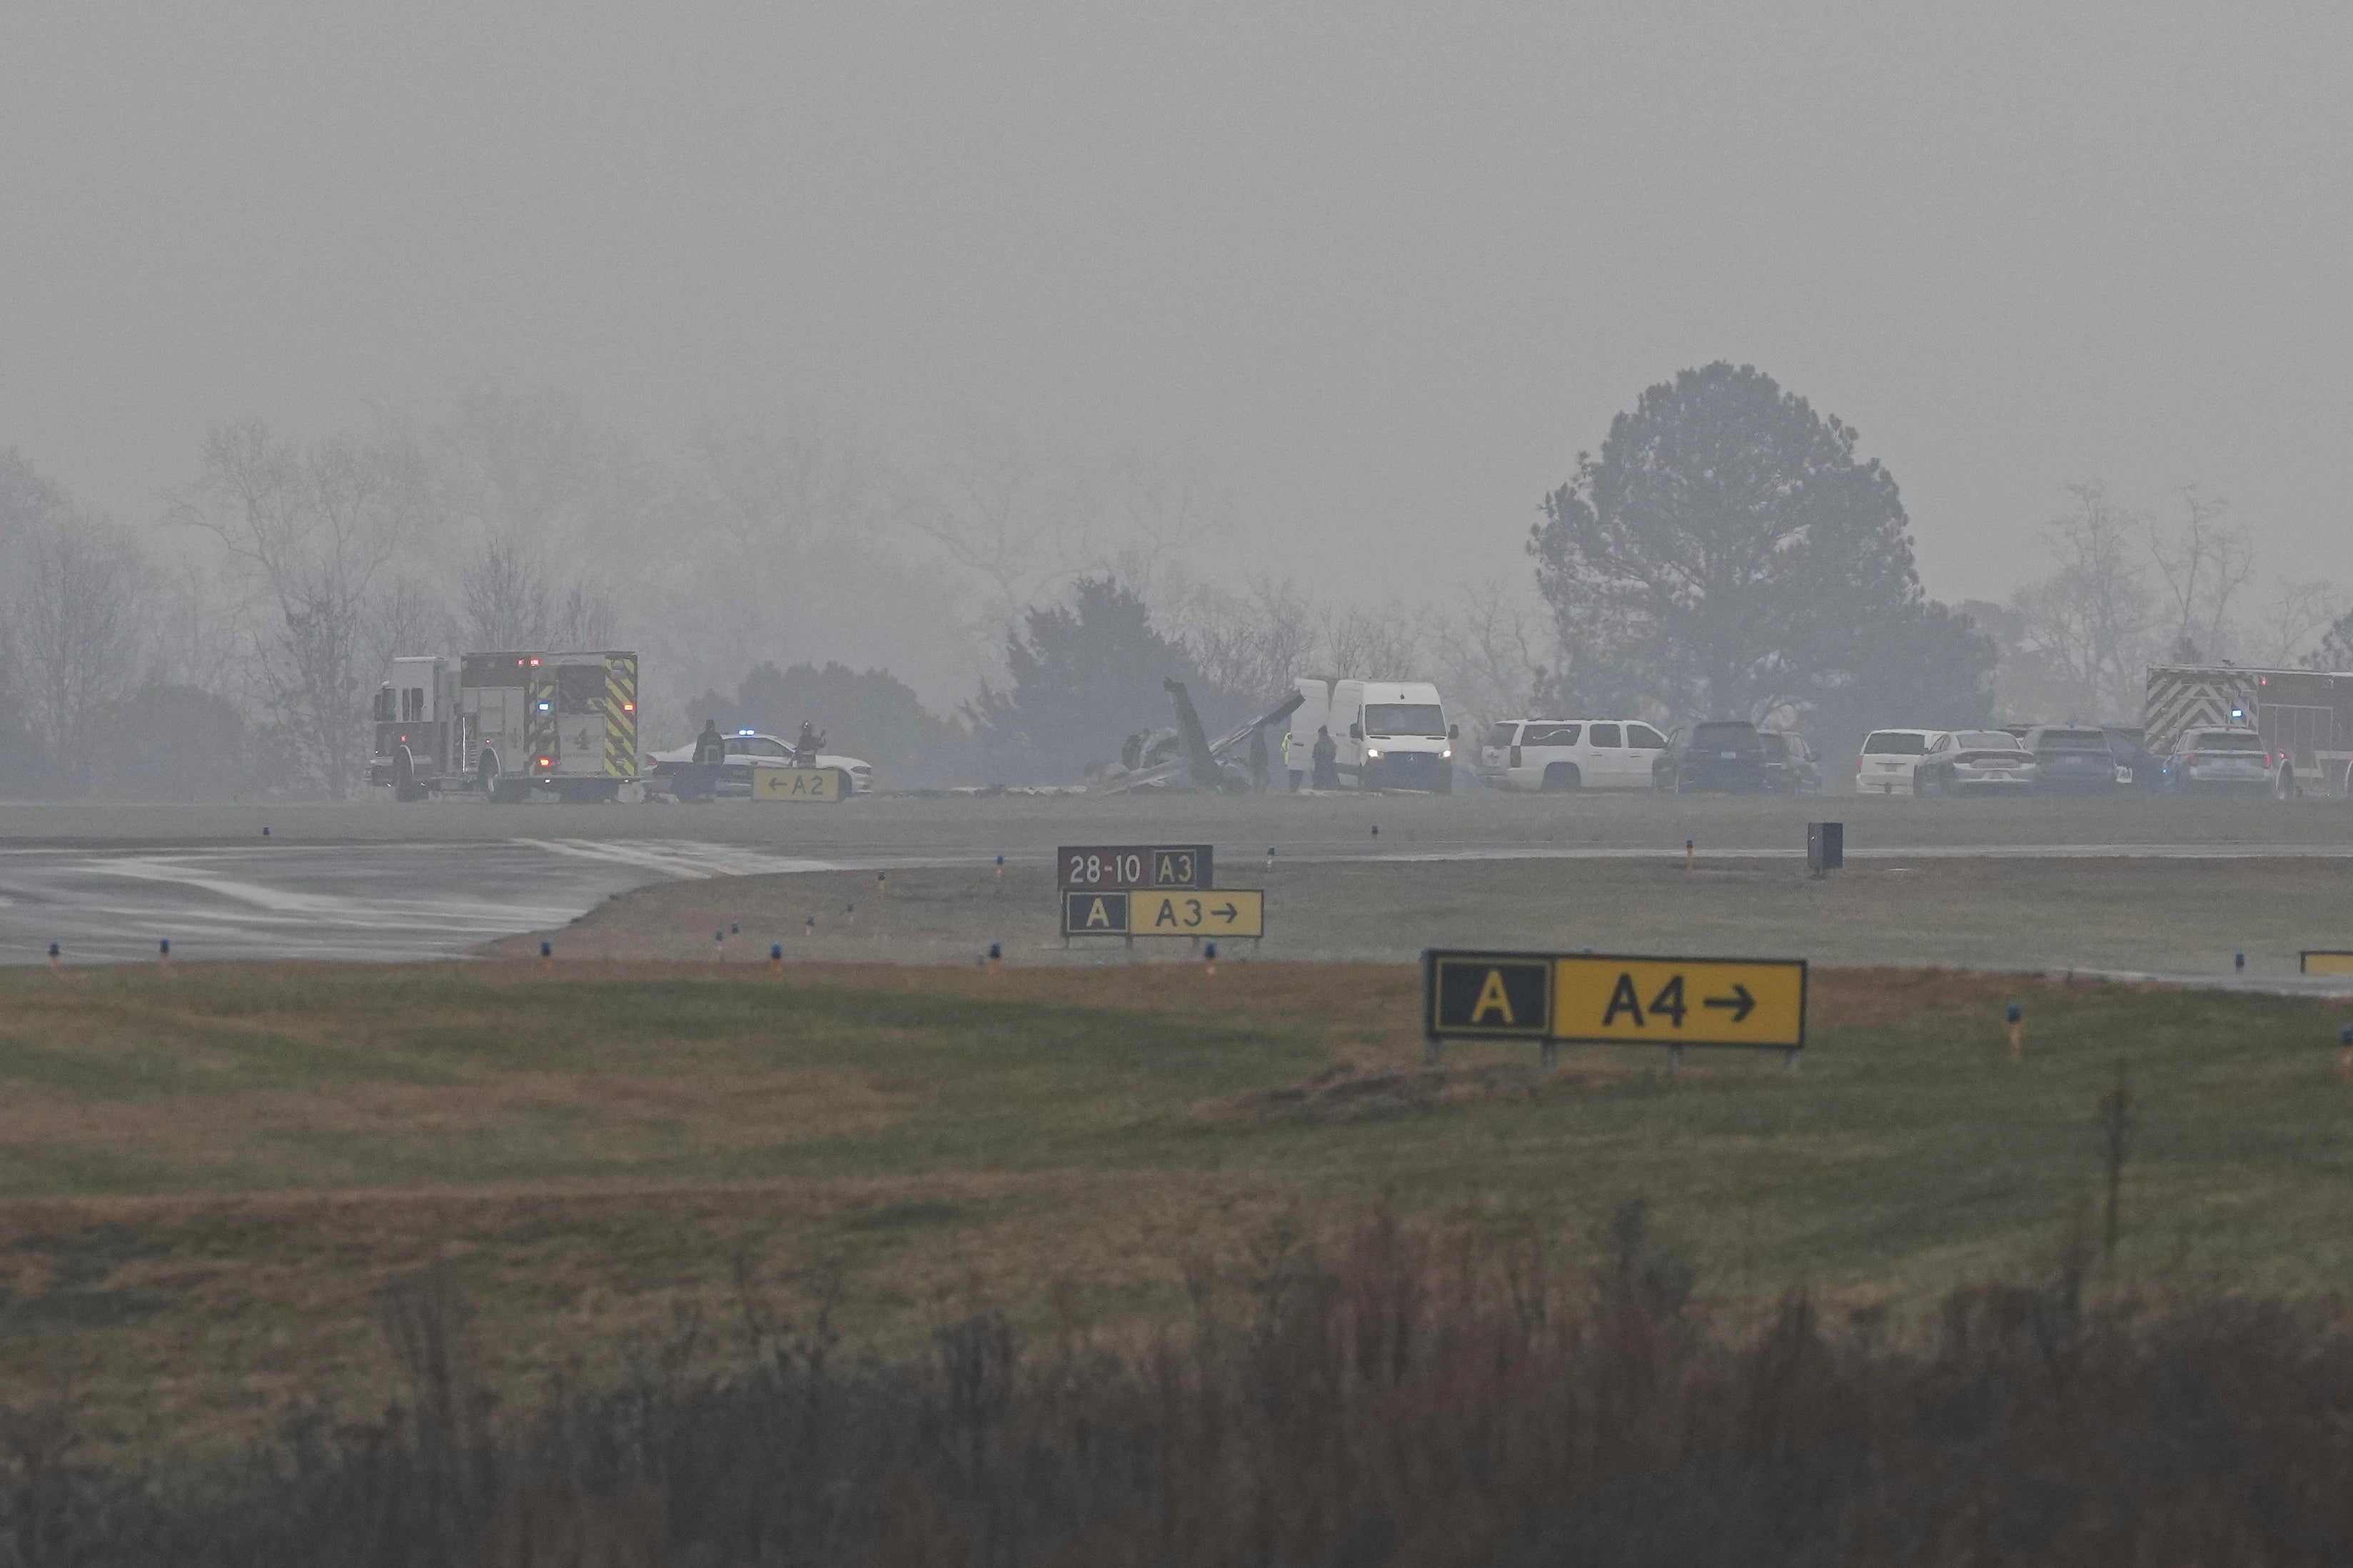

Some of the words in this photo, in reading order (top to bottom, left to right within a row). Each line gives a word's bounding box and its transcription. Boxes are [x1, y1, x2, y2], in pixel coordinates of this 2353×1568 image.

[573, 727, 590, 750] 4
[792, 775, 824, 794] A2
[1070, 855, 1141, 883] 28-10
[1158, 855, 1192, 883] A3
[1085, 897, 1109, 927] A
[1155, 898, 1202, 927] A3
[1471, 968, 1515, 1024] A
[1602, 972, 1687, 1028] A4
